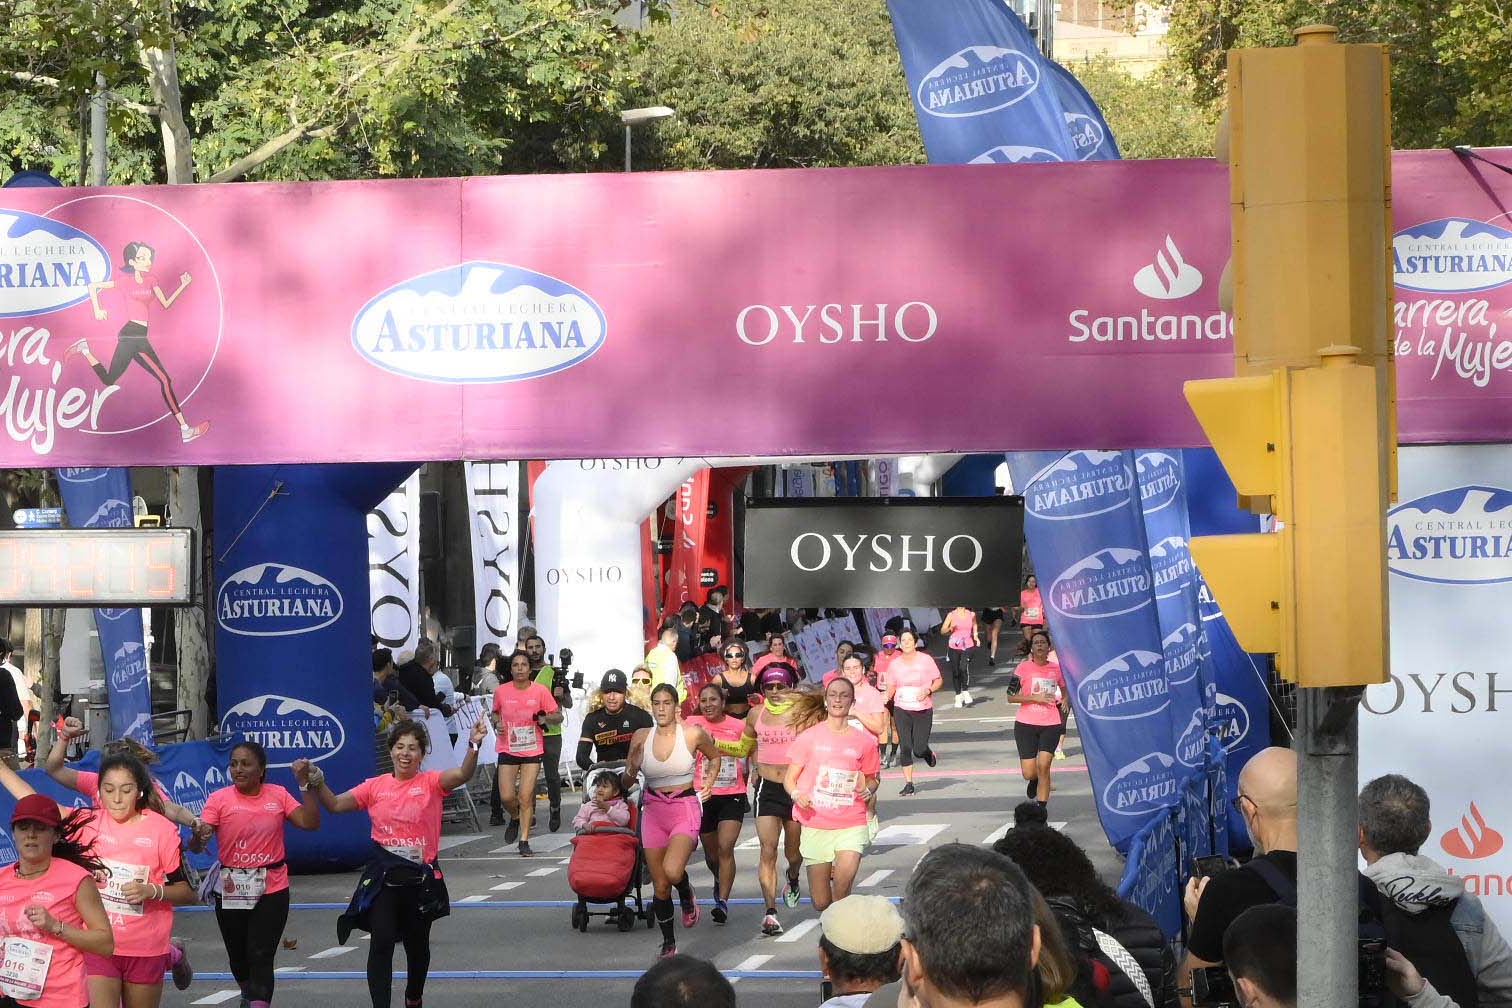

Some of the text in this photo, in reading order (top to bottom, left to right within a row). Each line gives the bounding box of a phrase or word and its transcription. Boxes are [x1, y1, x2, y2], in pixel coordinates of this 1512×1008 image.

[12, 244, 88, 257] LECHERA
[1408, 243, 1458, 252] CENTRAL
[1393, 298, 1489, 328] arrera
[371, 308, 587, 353] ASTURIANA
[735, 301, 938, 347] OYSHO
[1417, 328, 1435, 357] la
[1415, 520, 1482, 532] CENTRAL
[790, 532, 984, 575] OYSHO
[234, 587, 330, 597] CENTRAL LECHERA
[220, 592, 334, 621] ASTURIANA
[235, 719, 331, 729] CENTRAL LECHERA
[226, 725, 336, 749] TURIANA
[233, 853, 275, 864] DORSAL
[5, 960, 25, 972] 016
